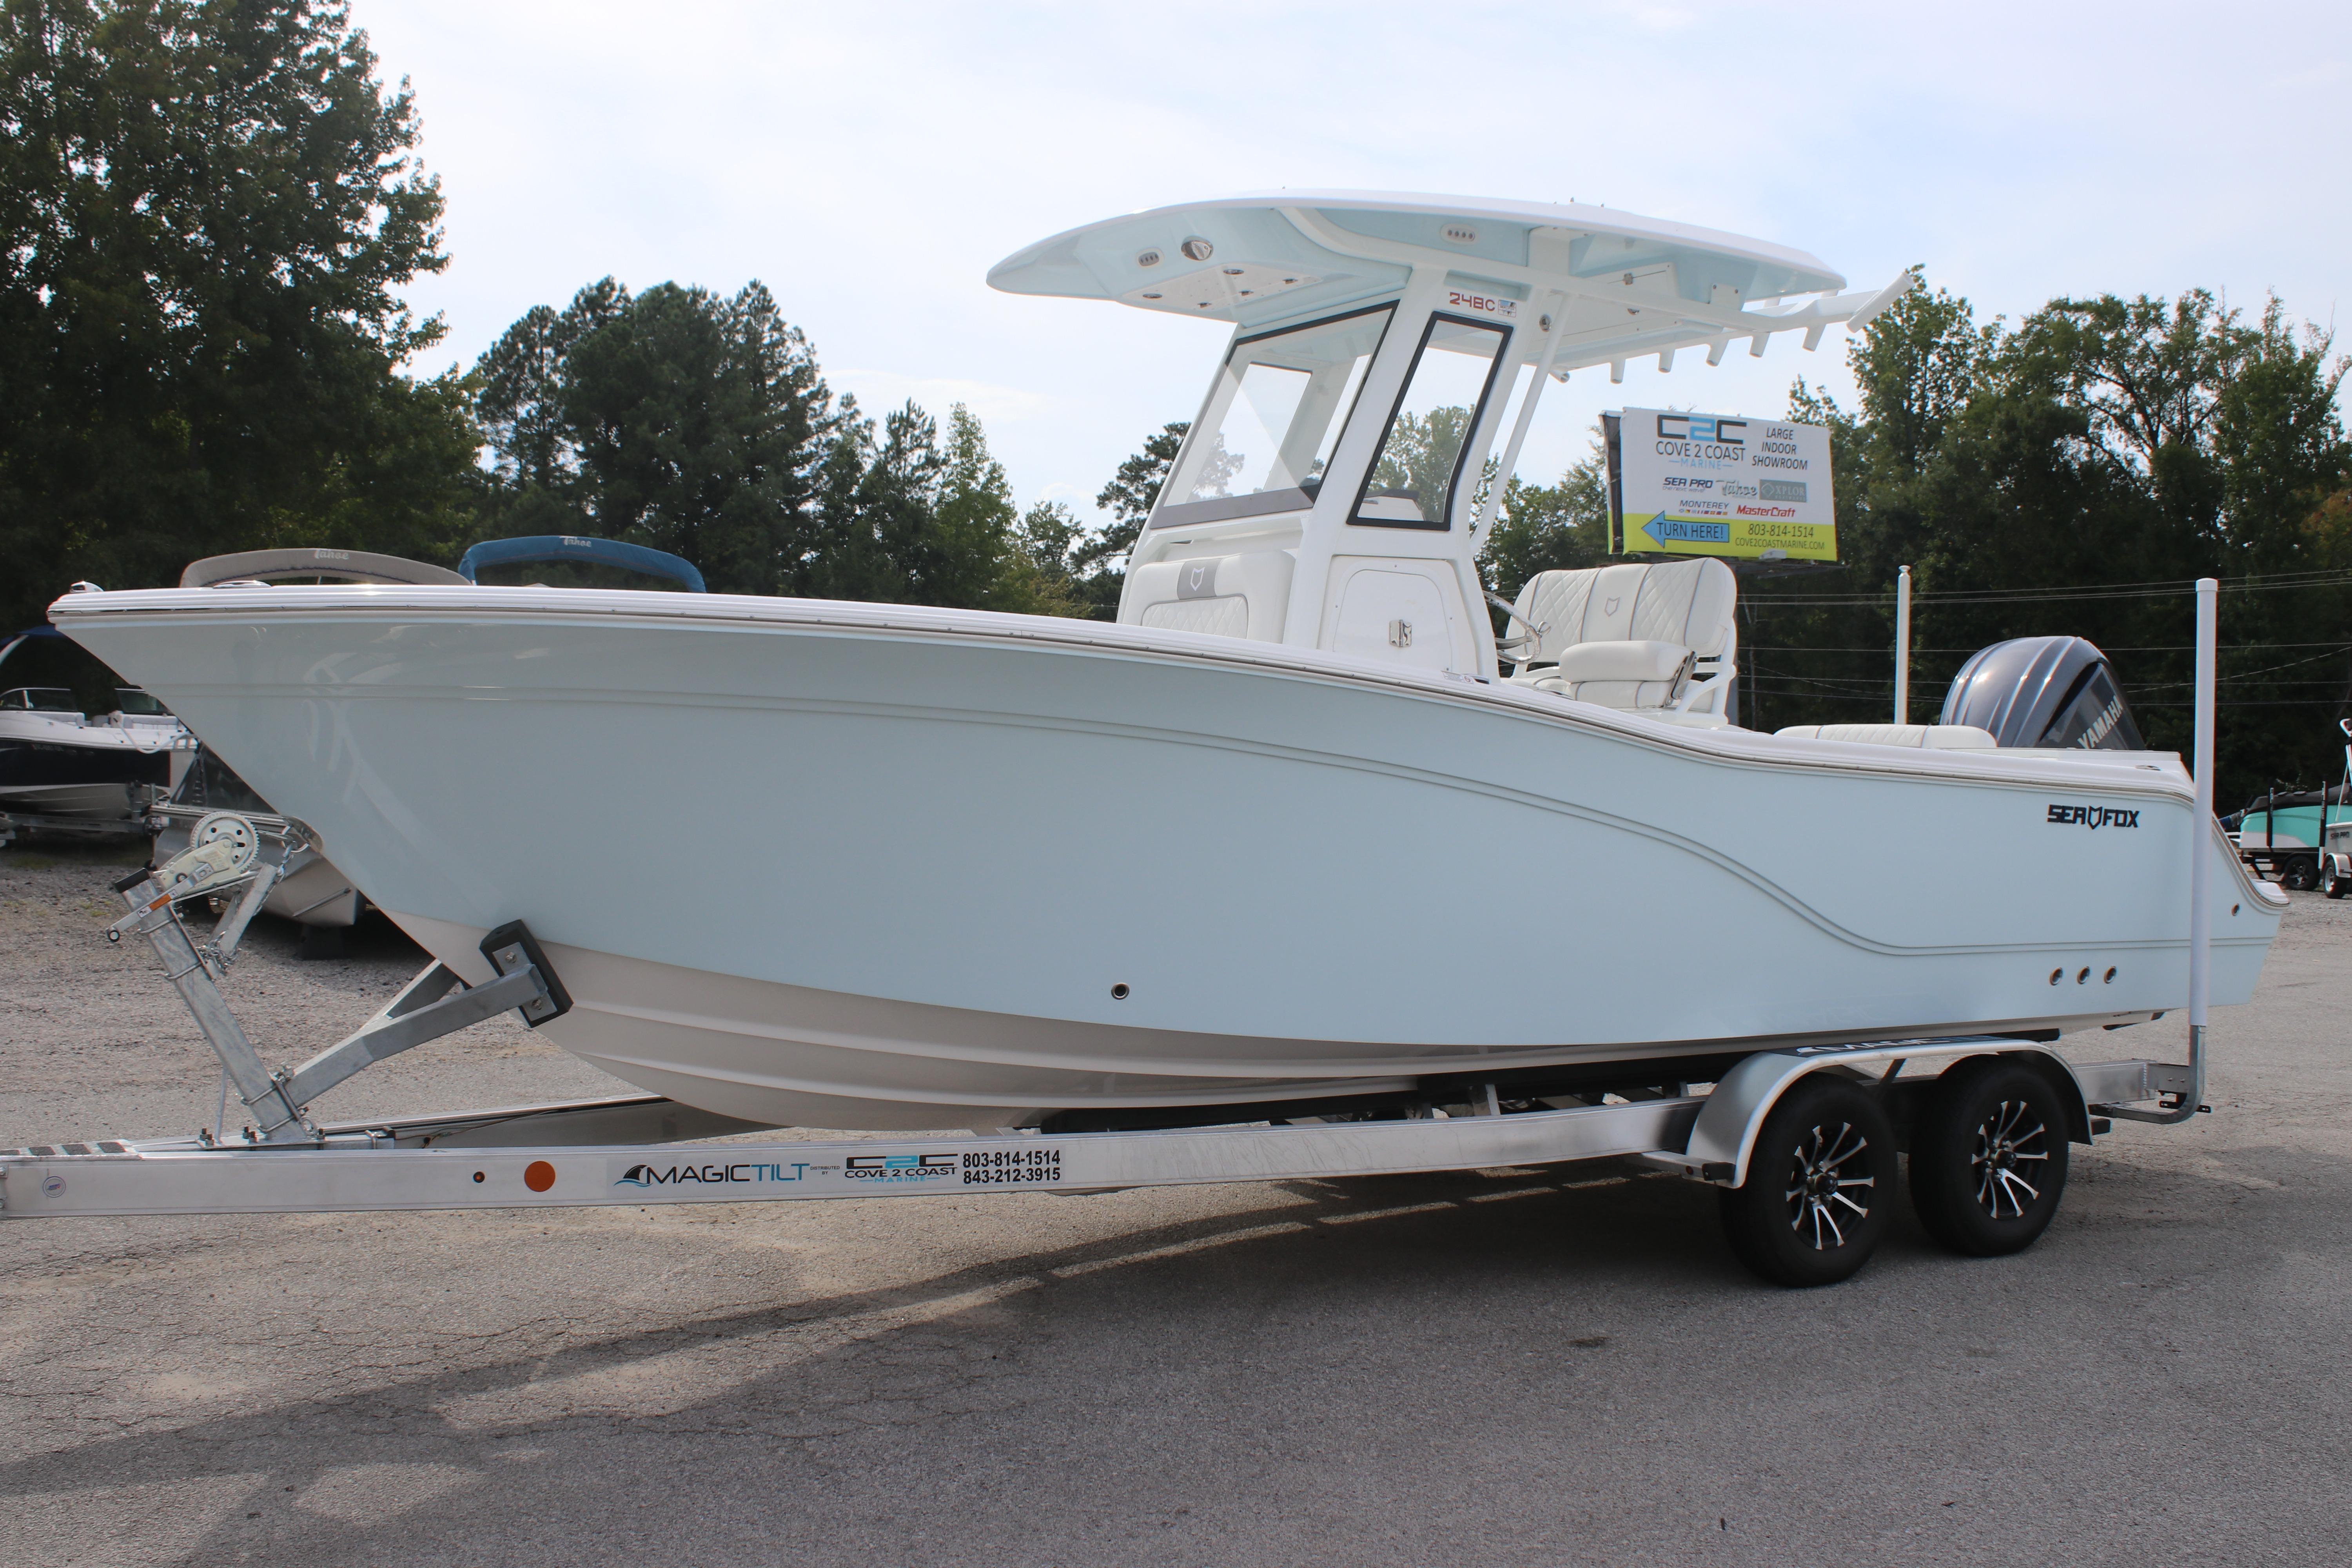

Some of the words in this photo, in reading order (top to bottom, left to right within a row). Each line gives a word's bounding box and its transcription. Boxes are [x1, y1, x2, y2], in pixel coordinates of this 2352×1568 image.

[1657, 415, 1747, 445] C2C
[1766, 427, 1793, 440] LARGE
[1656, 441, 1690, 457] COVE
[1694, 444, 1701, 457] 2
[1705, 445, 1746, 461] COAST
[1762, 442, 1796, 454] INDOOR
[1681, 458, 1721, 470] MARINE
[1752, 455, 1808, 470] SHOWROOM
[1663, 477, 1686, 486] SEA
[1689, 479, 1713, 488] PRO
[1716, 480, 1757, 496] Tahoe
[1775, 486, 1806, 496] XPLOR
[1680, 500, 1729, 509] MONTEREY
[1737, 505, 1795, 517] MasterCraft
[1657, 523, 1687, 537] TURN
[1691, 524, 1723, 539] HERE!
[1748, 523, 1814, 537] 803-814-1514
[559, 536, 592, 547] Tahoe
[1735, 537, 1825, 550] COVE2COASTMARINE.COM
[2077, 695, 2123, 749] YAMAHA
[2047, 804, 2087, 825] SEA
[2102, 809, 2140, 828] FOX
[847, 1154, 958, 1169] C2C
[963, 1150, 1060, 1168] 803-814-1514
[647, 1163, 810, 1183] MAGICTILT
[845, 1169, 887, 1178] COVE
[905, 1167, 958, 1176] COAST
[963, 1167, 1061, 1184] 843-212-3915
